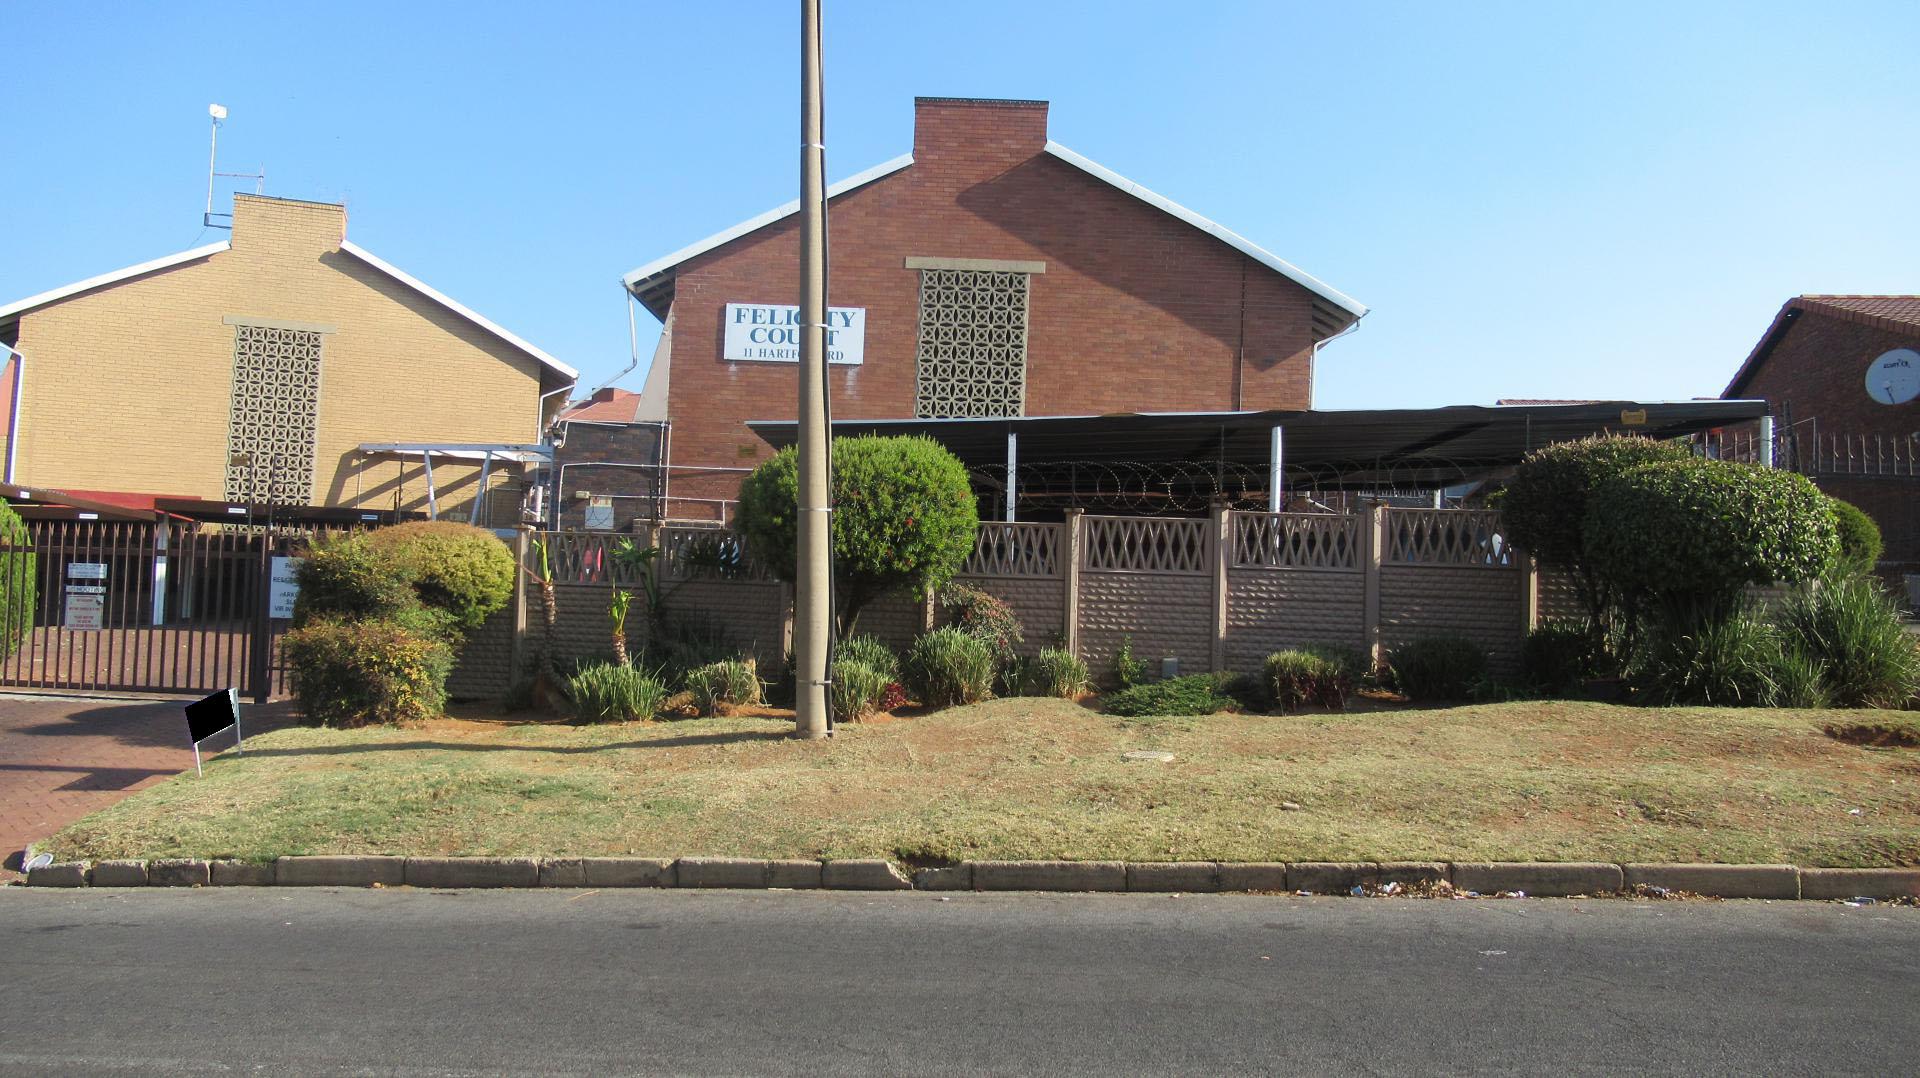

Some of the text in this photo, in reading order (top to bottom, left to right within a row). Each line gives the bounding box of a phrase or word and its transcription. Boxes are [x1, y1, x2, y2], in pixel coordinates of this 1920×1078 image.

[734, 307, 856, 328] FELITY
[750, 327, 839, 346] COUT
[759, 348, 800, 360] HARTF
